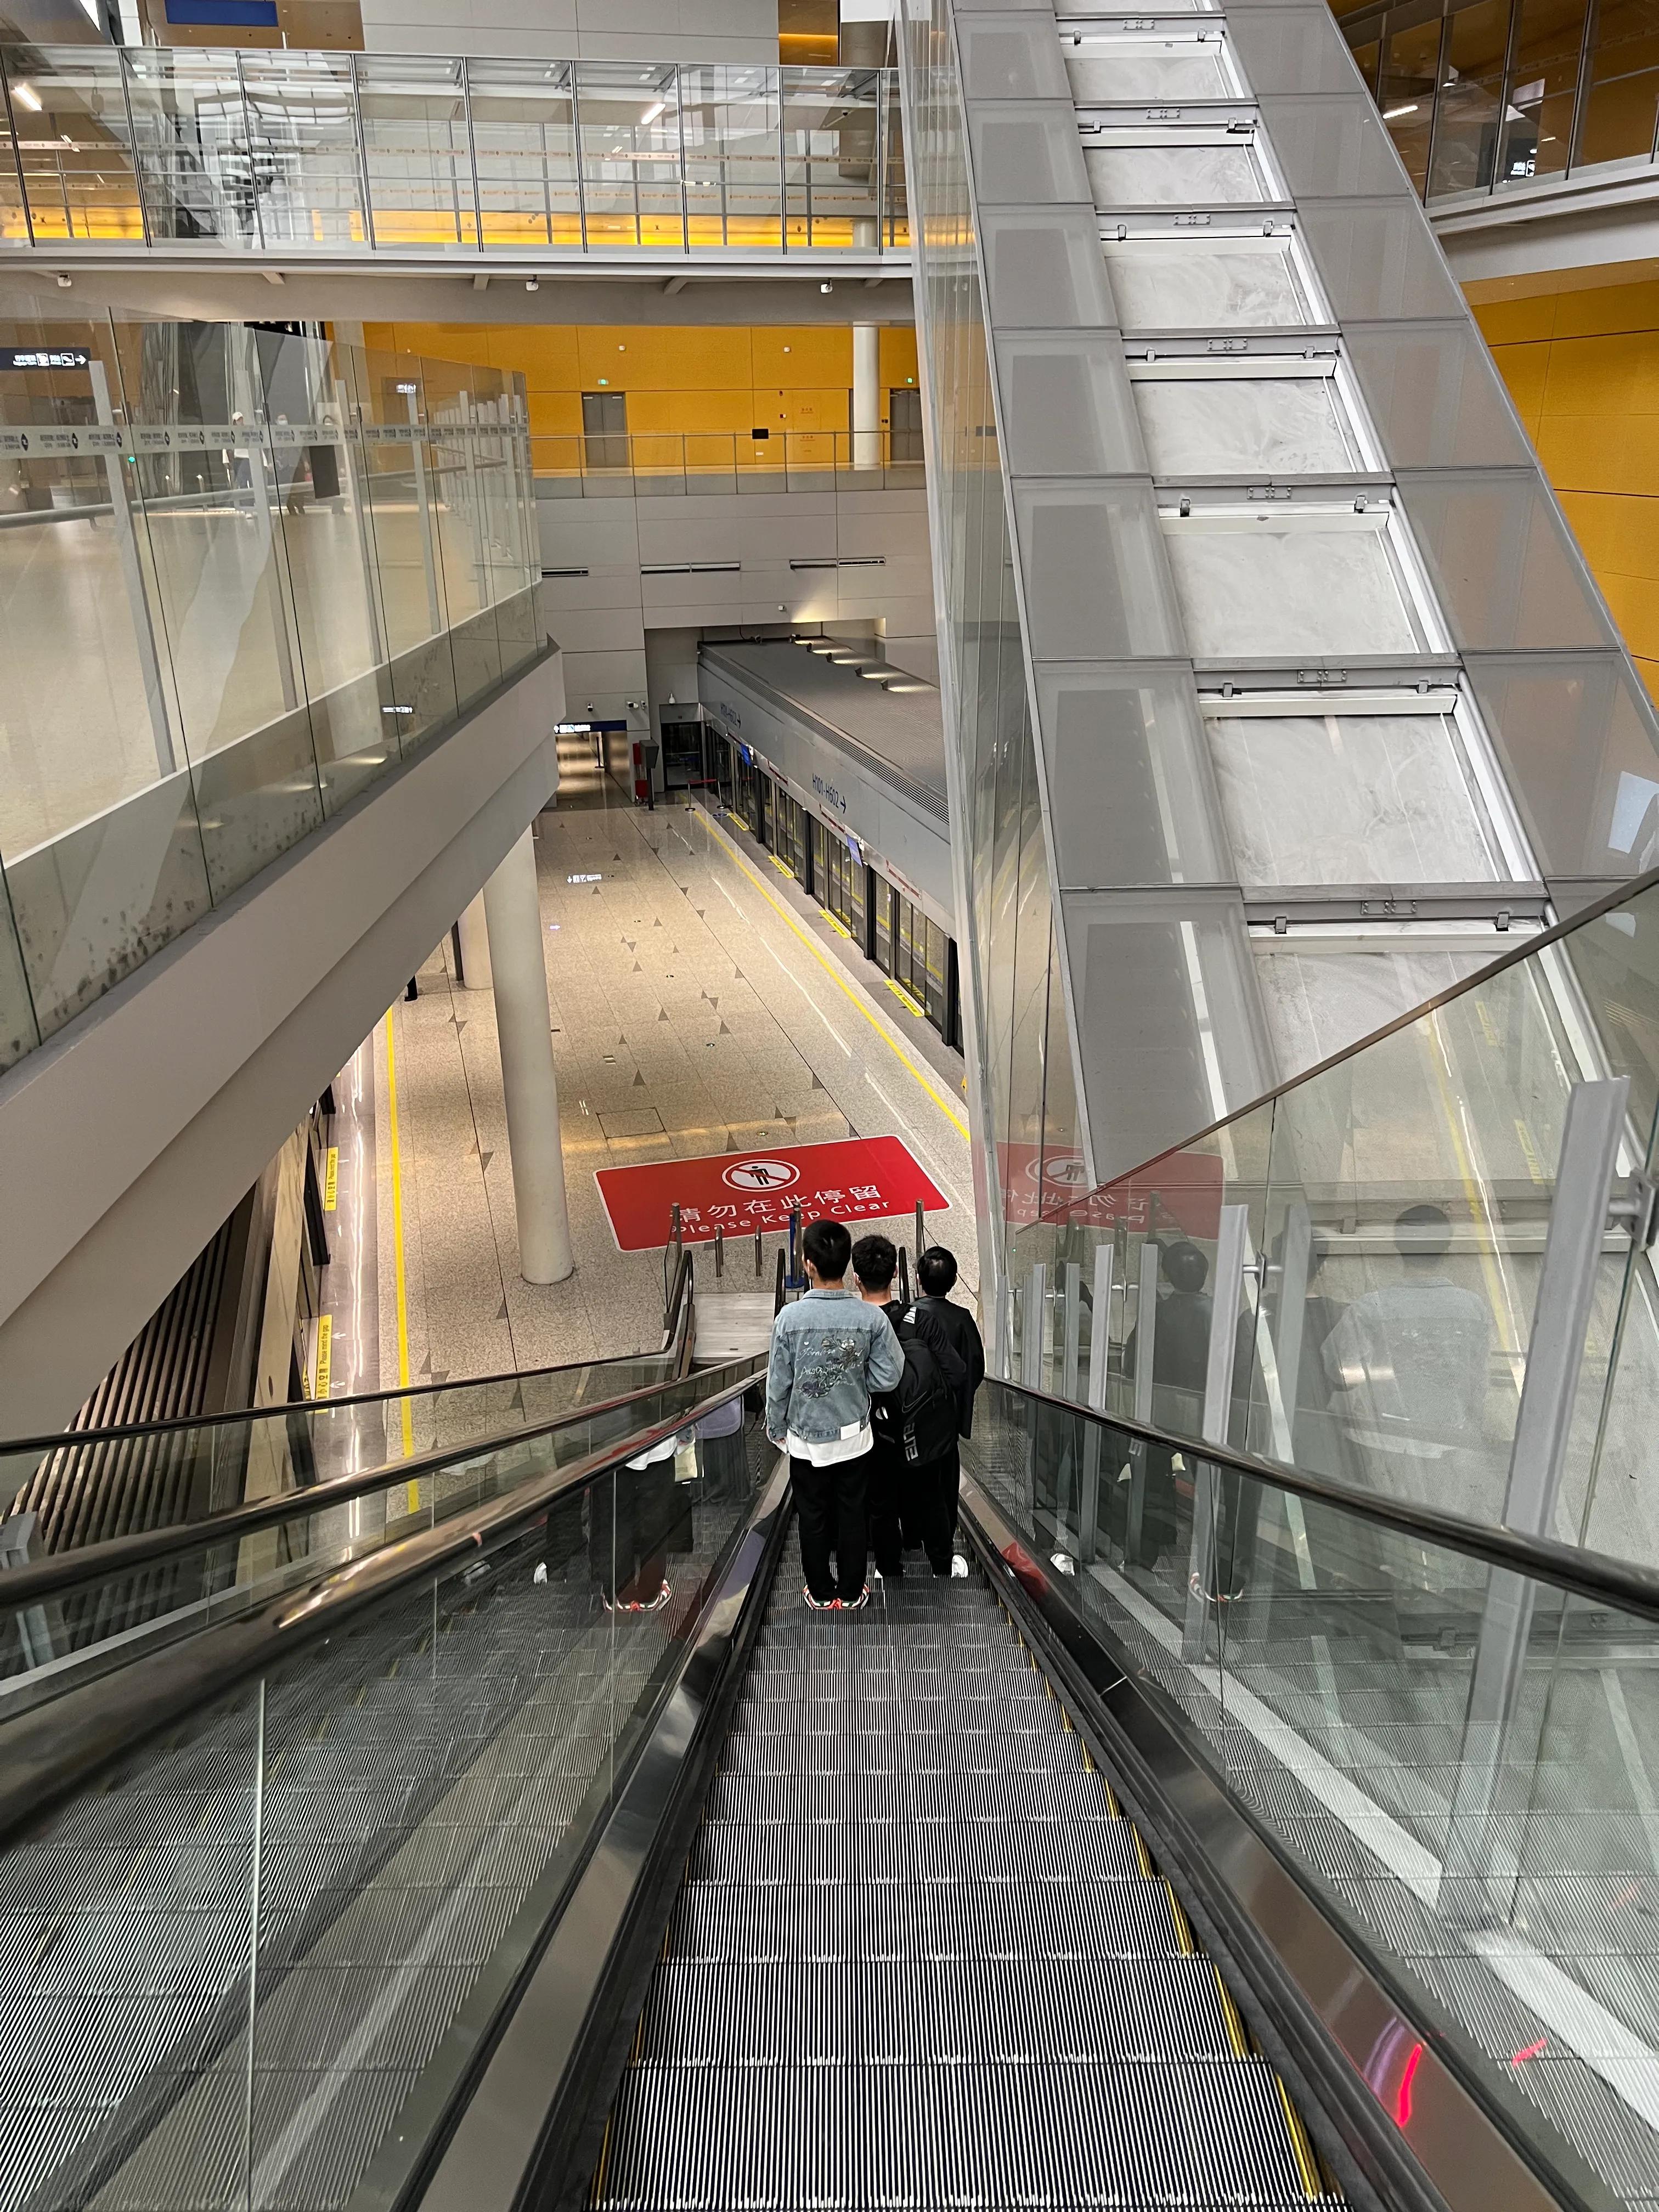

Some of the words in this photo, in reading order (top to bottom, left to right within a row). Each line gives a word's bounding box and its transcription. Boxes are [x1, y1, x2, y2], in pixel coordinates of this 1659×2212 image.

[812, 772, 839, 809] H101-H602
[669, 1184, 881, 1223] 请勿在此停留
[831, 1201, 889, 1215] Clear
